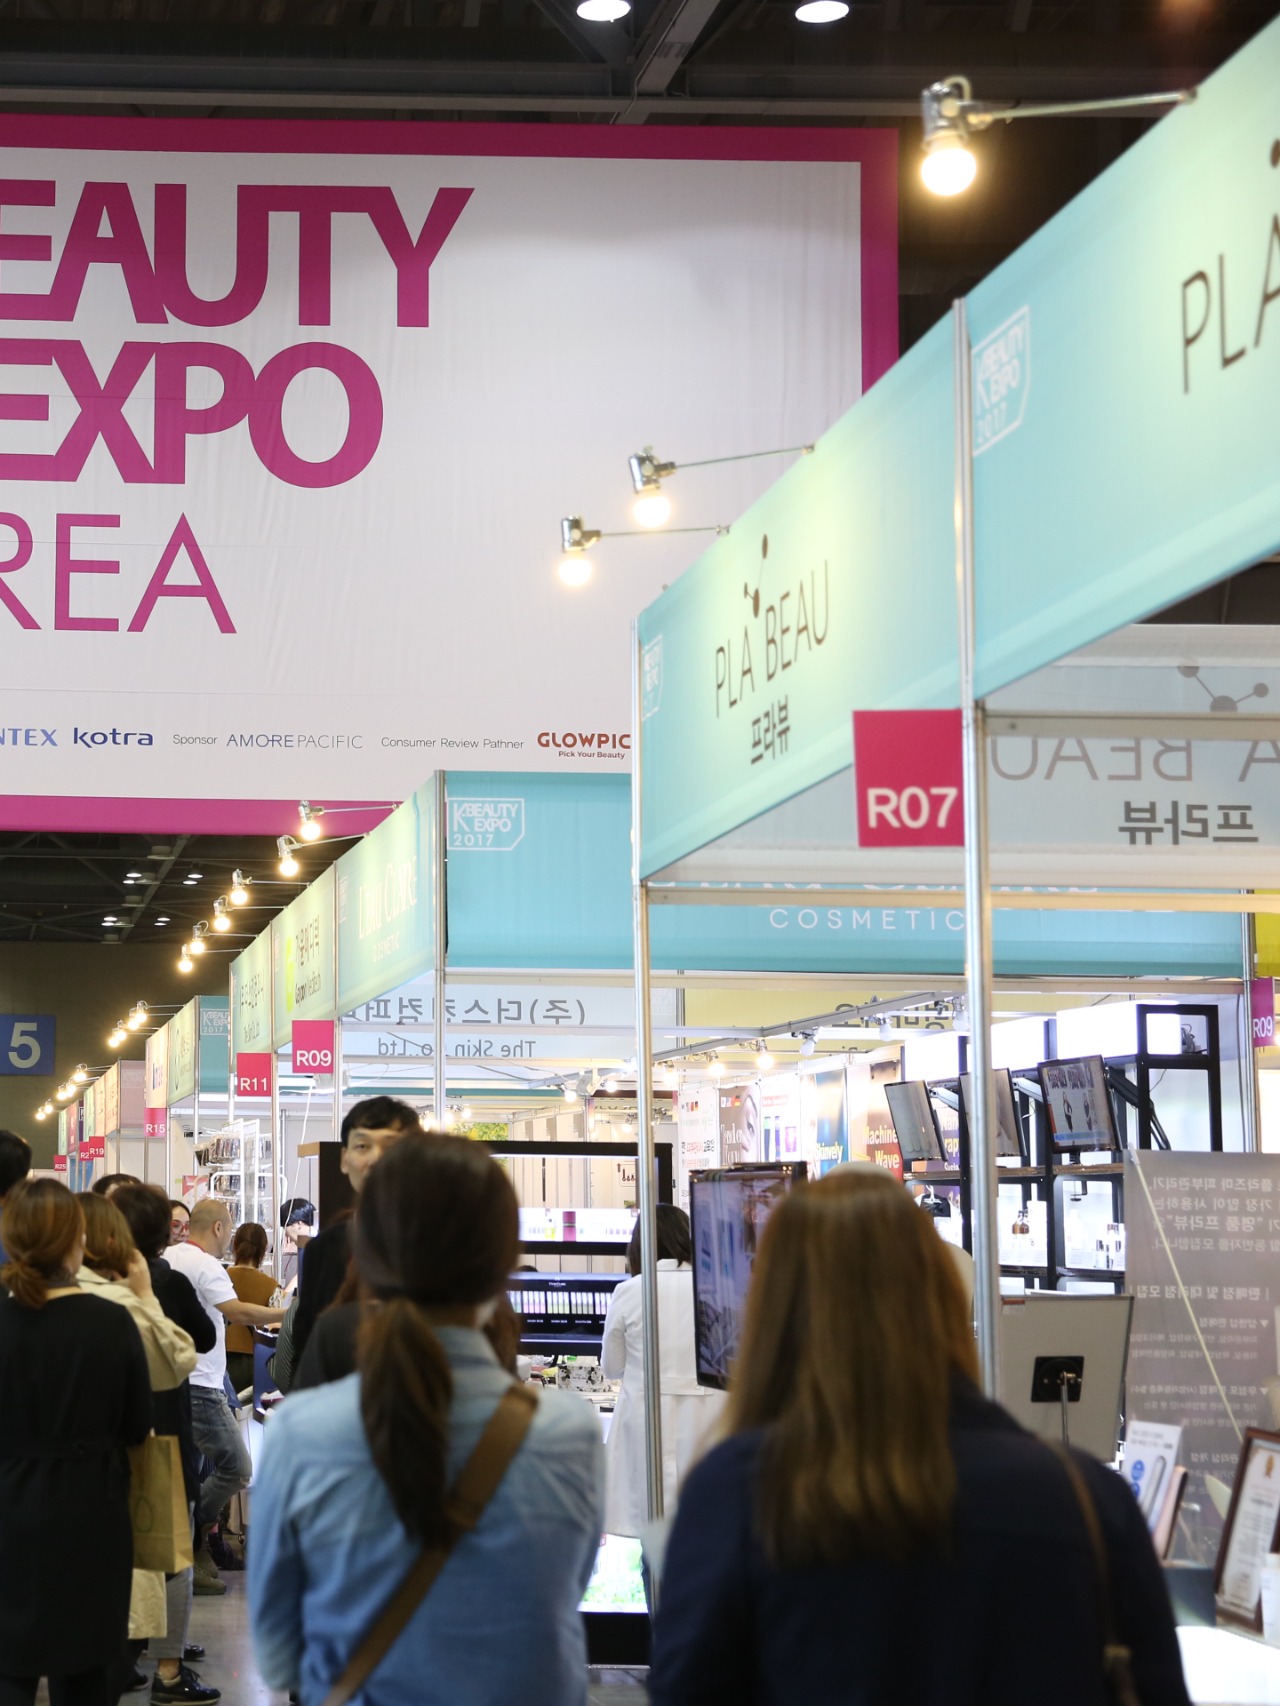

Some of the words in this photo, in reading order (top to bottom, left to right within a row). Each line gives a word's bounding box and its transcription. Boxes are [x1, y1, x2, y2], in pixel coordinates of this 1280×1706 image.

[715, 625, 755, 719] PLA
[765, 560, 829, 682] BEAU
[73, 727, 154, 748] kotra
[750, 694, 790, 765] 프라뷰
[172, 733, 218, 747] Sponsor
[381, 737, 437, 749] Consumer
[440, 737, 479, 749] Review
[483, 738, 524, 750] Pathner
[558, 750, 575, 758] Pick
[597, 751, 625, 760] Beauty
[867, 786, 958, 830] R07
[474, 818, 512, 832] EXPO
[453, 833, 494, 846] 2017
[769, 908, 966, 931] COSMETIC
[1253, 1018, 1273, 1039] R09
[8, 1022, 41, 1069] 5
[296, 1050, 332, 1067] R09
[240, 1078, 269, 1092] R11
[145, 1123, 166, 1134] R15
[863, 1125, 898, 1145] Machine
[89, 1147, 104, 1156] R19
[874, 1150, 900, 1169] Wave
